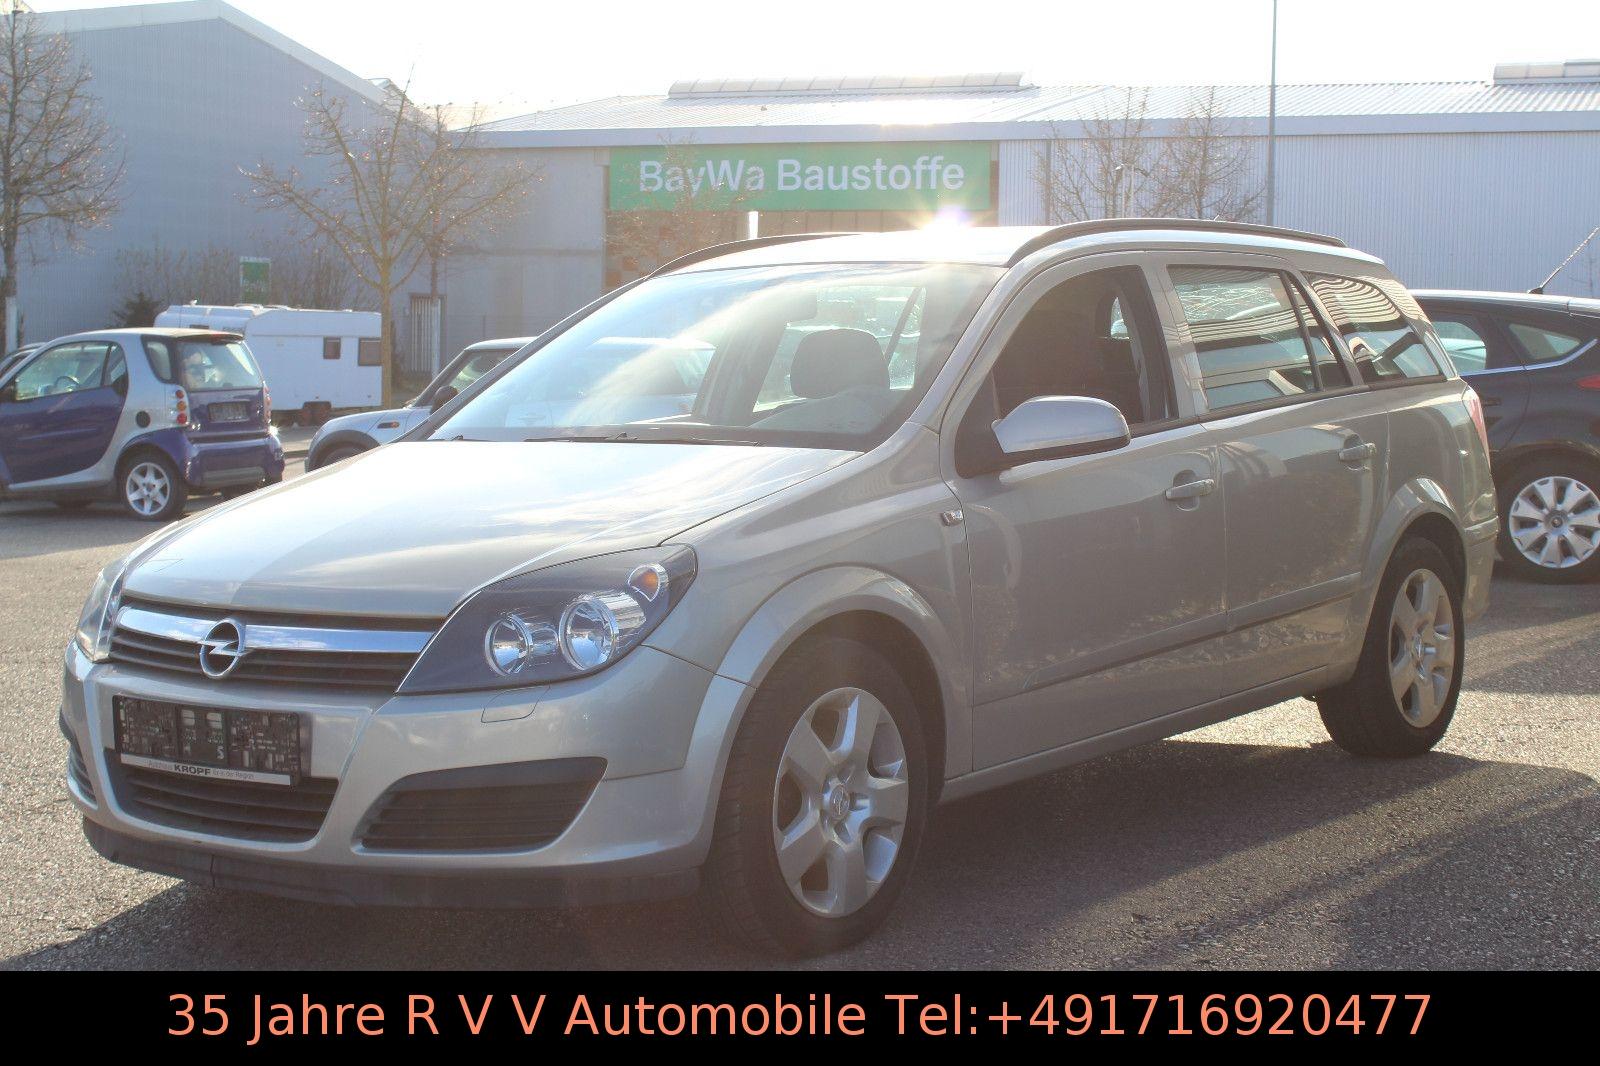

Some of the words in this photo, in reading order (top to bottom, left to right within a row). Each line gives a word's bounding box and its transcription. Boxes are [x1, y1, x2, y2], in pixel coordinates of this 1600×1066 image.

[638, 158, 765, 197] BayWa
[777, 155, 965, 191] Baustoffe
[174, 763, 212, 776] KROPF
